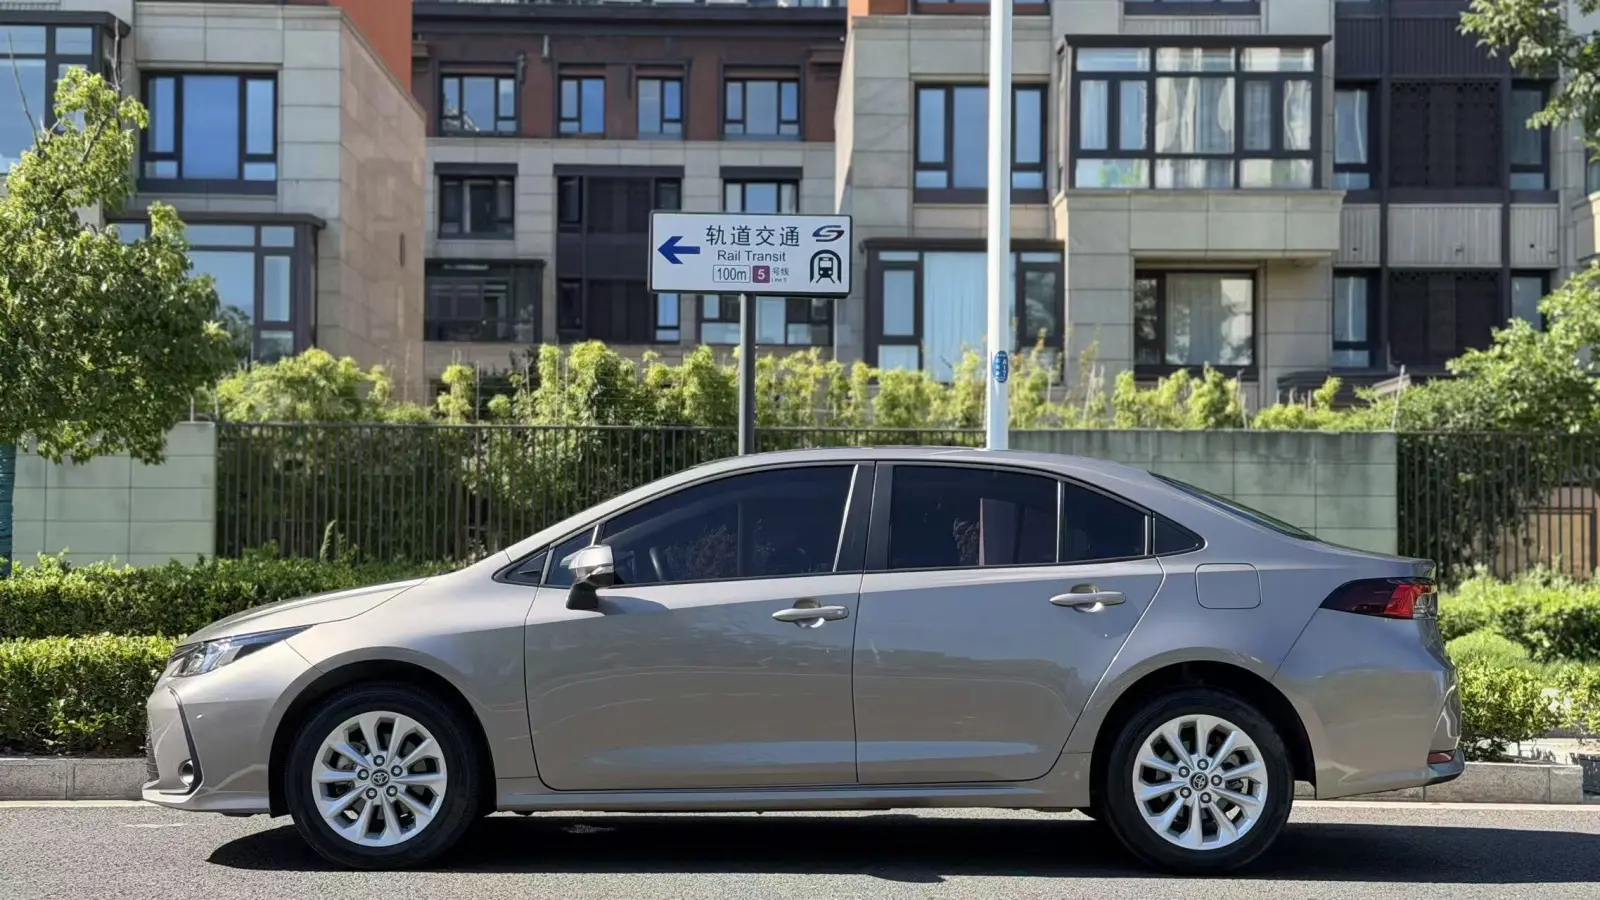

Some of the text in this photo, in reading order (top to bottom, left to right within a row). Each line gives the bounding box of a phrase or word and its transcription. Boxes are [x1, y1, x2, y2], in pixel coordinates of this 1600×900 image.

[705, 225, 800, 247] 轨道交通
[717, 251, 786, 262] Rail Transit
[717, 268, 747, 281] 100m
[757, 267, 789, 280] 5 号线
